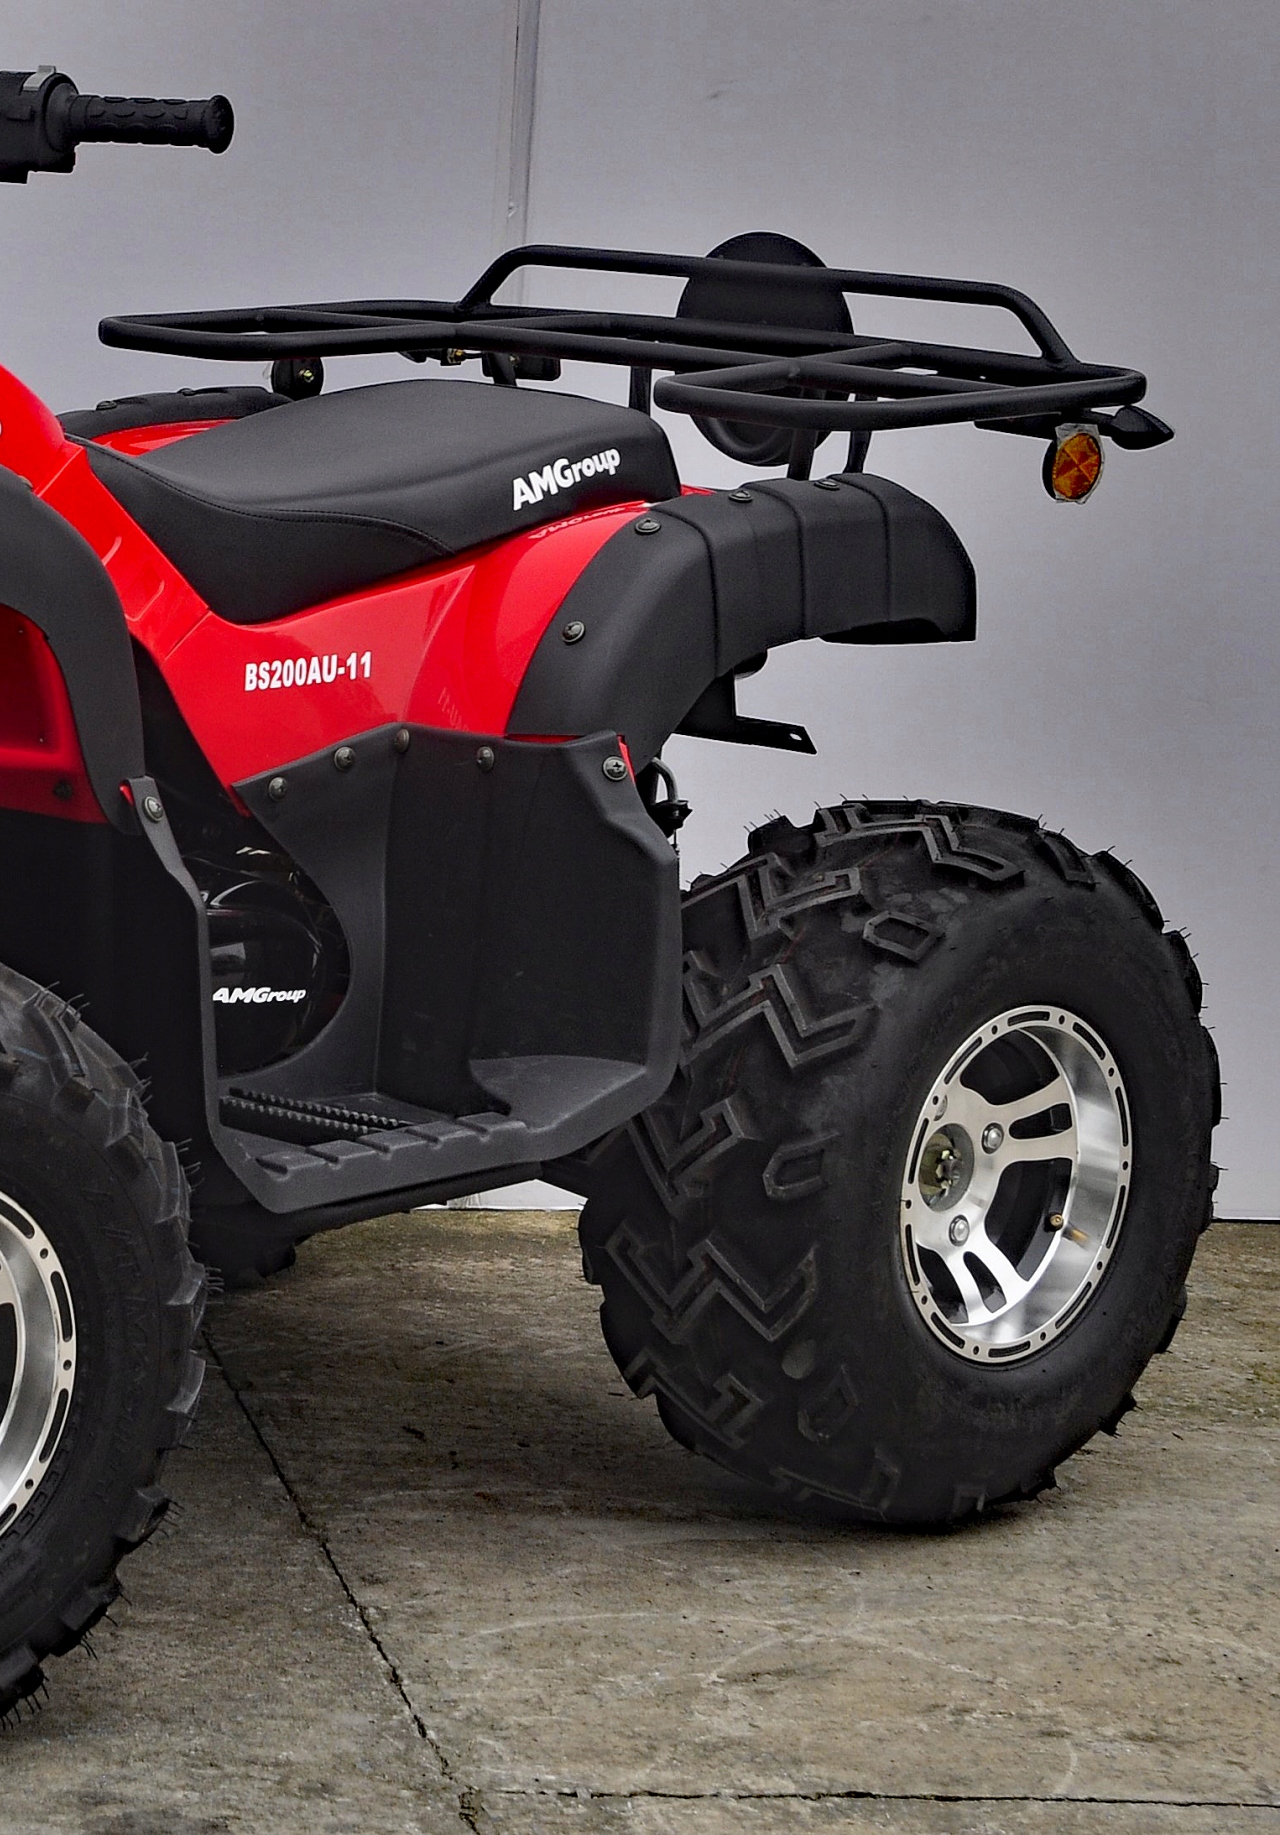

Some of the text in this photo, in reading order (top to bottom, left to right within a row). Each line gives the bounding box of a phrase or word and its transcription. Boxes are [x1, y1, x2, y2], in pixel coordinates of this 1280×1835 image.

[513, 448, 621, 511] AMGroup
[244, 651, 372, 692] BS200AU-11
[212, 986, 307, 1004] AMGroup
